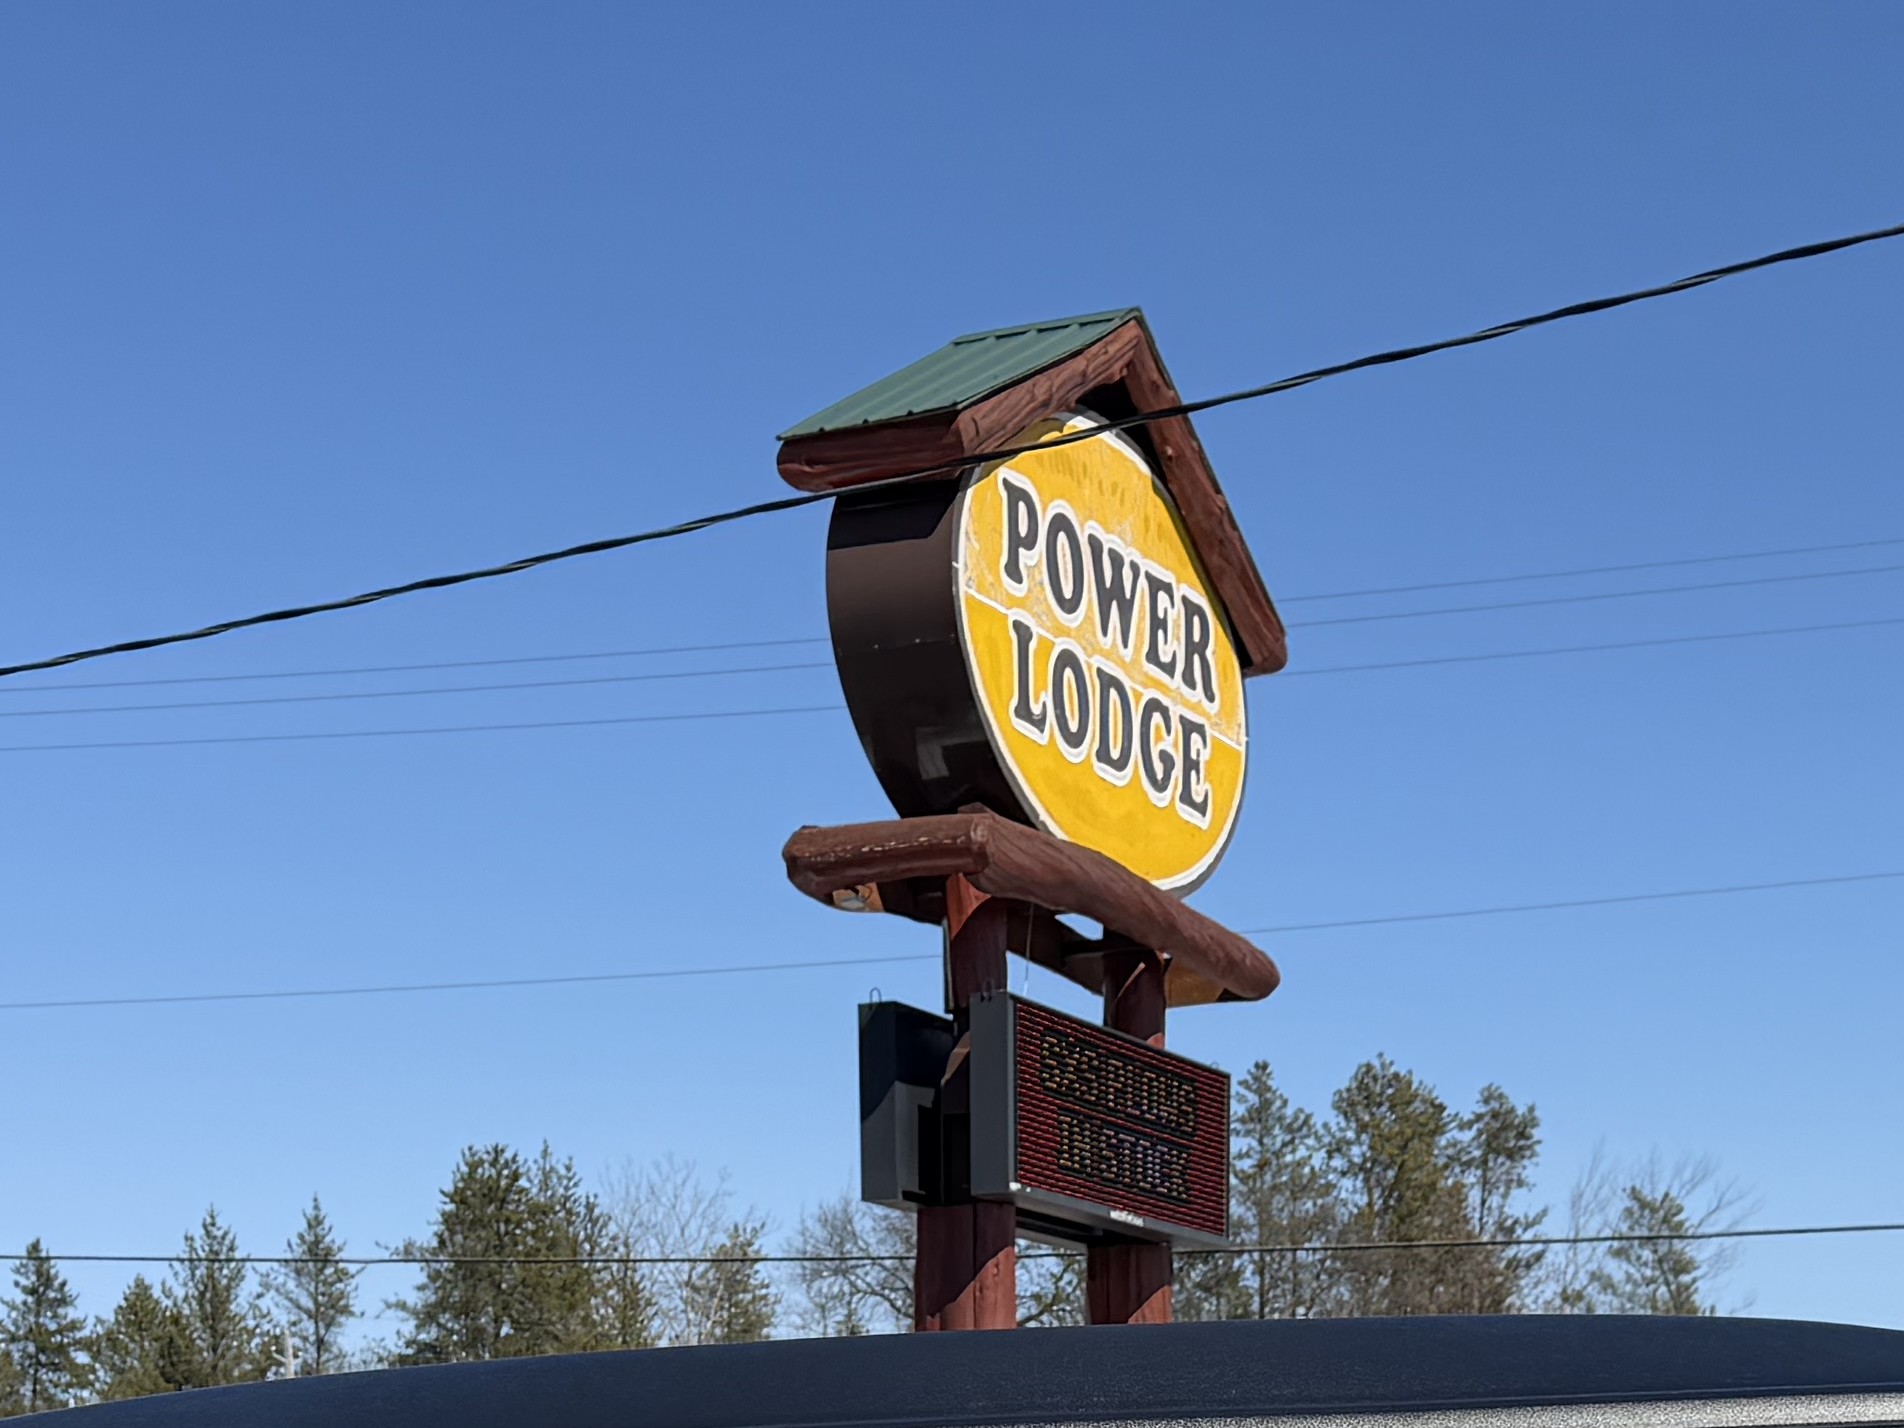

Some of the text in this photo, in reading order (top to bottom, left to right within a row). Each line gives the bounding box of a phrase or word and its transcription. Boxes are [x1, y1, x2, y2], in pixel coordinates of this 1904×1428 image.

[999, 472, 1217, 708] POWER
[1010, 614, 1212, 823] LODGE
[1058, 1115, 1188, 1199] IN STOCK
